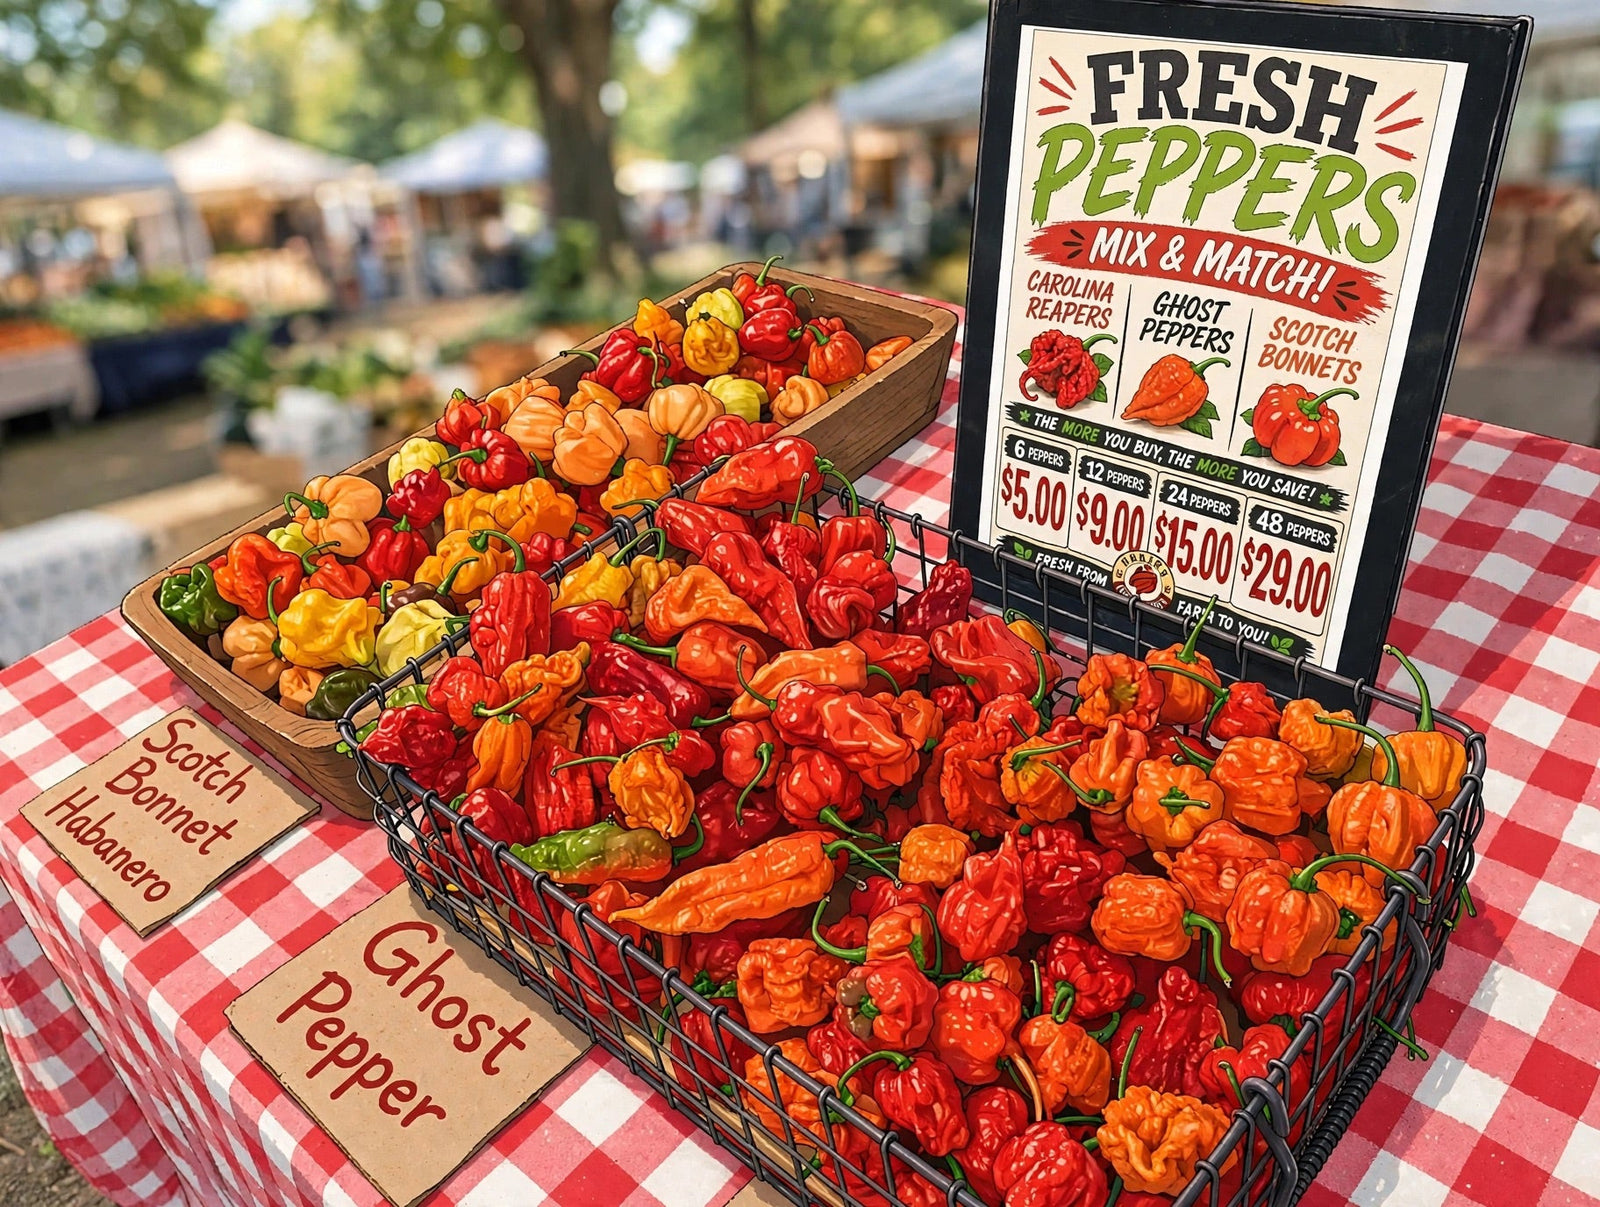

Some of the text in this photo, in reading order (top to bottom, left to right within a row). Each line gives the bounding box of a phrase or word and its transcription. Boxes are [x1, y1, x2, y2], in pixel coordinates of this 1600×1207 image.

[1087, 49, 1378, 154] FRESH
[1031, 123, 1416, 263] PEPPERS
[1027, 270, 1114, 303] CAROLINA
[1088, 226, 1337, 304] MIX & MATCH!
[1025, 296, 1113, 329] REAPERS
[1139, 318, 1234, 354] PEPPERS
[1153, 291, 1231, 324] GHOST
[1268, 316, 1357, 355] SCOTCH
[1257, 343, 1362, 385] BONNETS
[1014, 440, 1064, 467] 6 PEPPERS
[1034, 413, 1317, 502] THE MORE YOU BUY, THE MORE YOU SAVE!
[1085, 460, 1144, 492] 12 PEPPERS
[1001, 463, 1067, 531] $5.00
[1076, 487, 1145, 551] $9.00
[1167, 484, 1232, 517] 24 PEPPERS
[1256, 510, 1331, 547] 48 PEPPERS
[1035, 552, 1074, 573] FRESH
[1076, 564, 1108, 587] FROM
[1154, 510, 1233, 585] $15.00
[1241, 536, 1331, 618] $29.00
[1218, 613, 1233, 630] TO
[1238, 621, 1270, 645] YOU!
[142, 718, 254, 804] Scotch
[105, 756, 238, 856] Bonnet
[44, 786, 171, 902] Habanero
[363, 920, 532, 1076] Ghost
[276, 970, 446, 1128] Pepper
